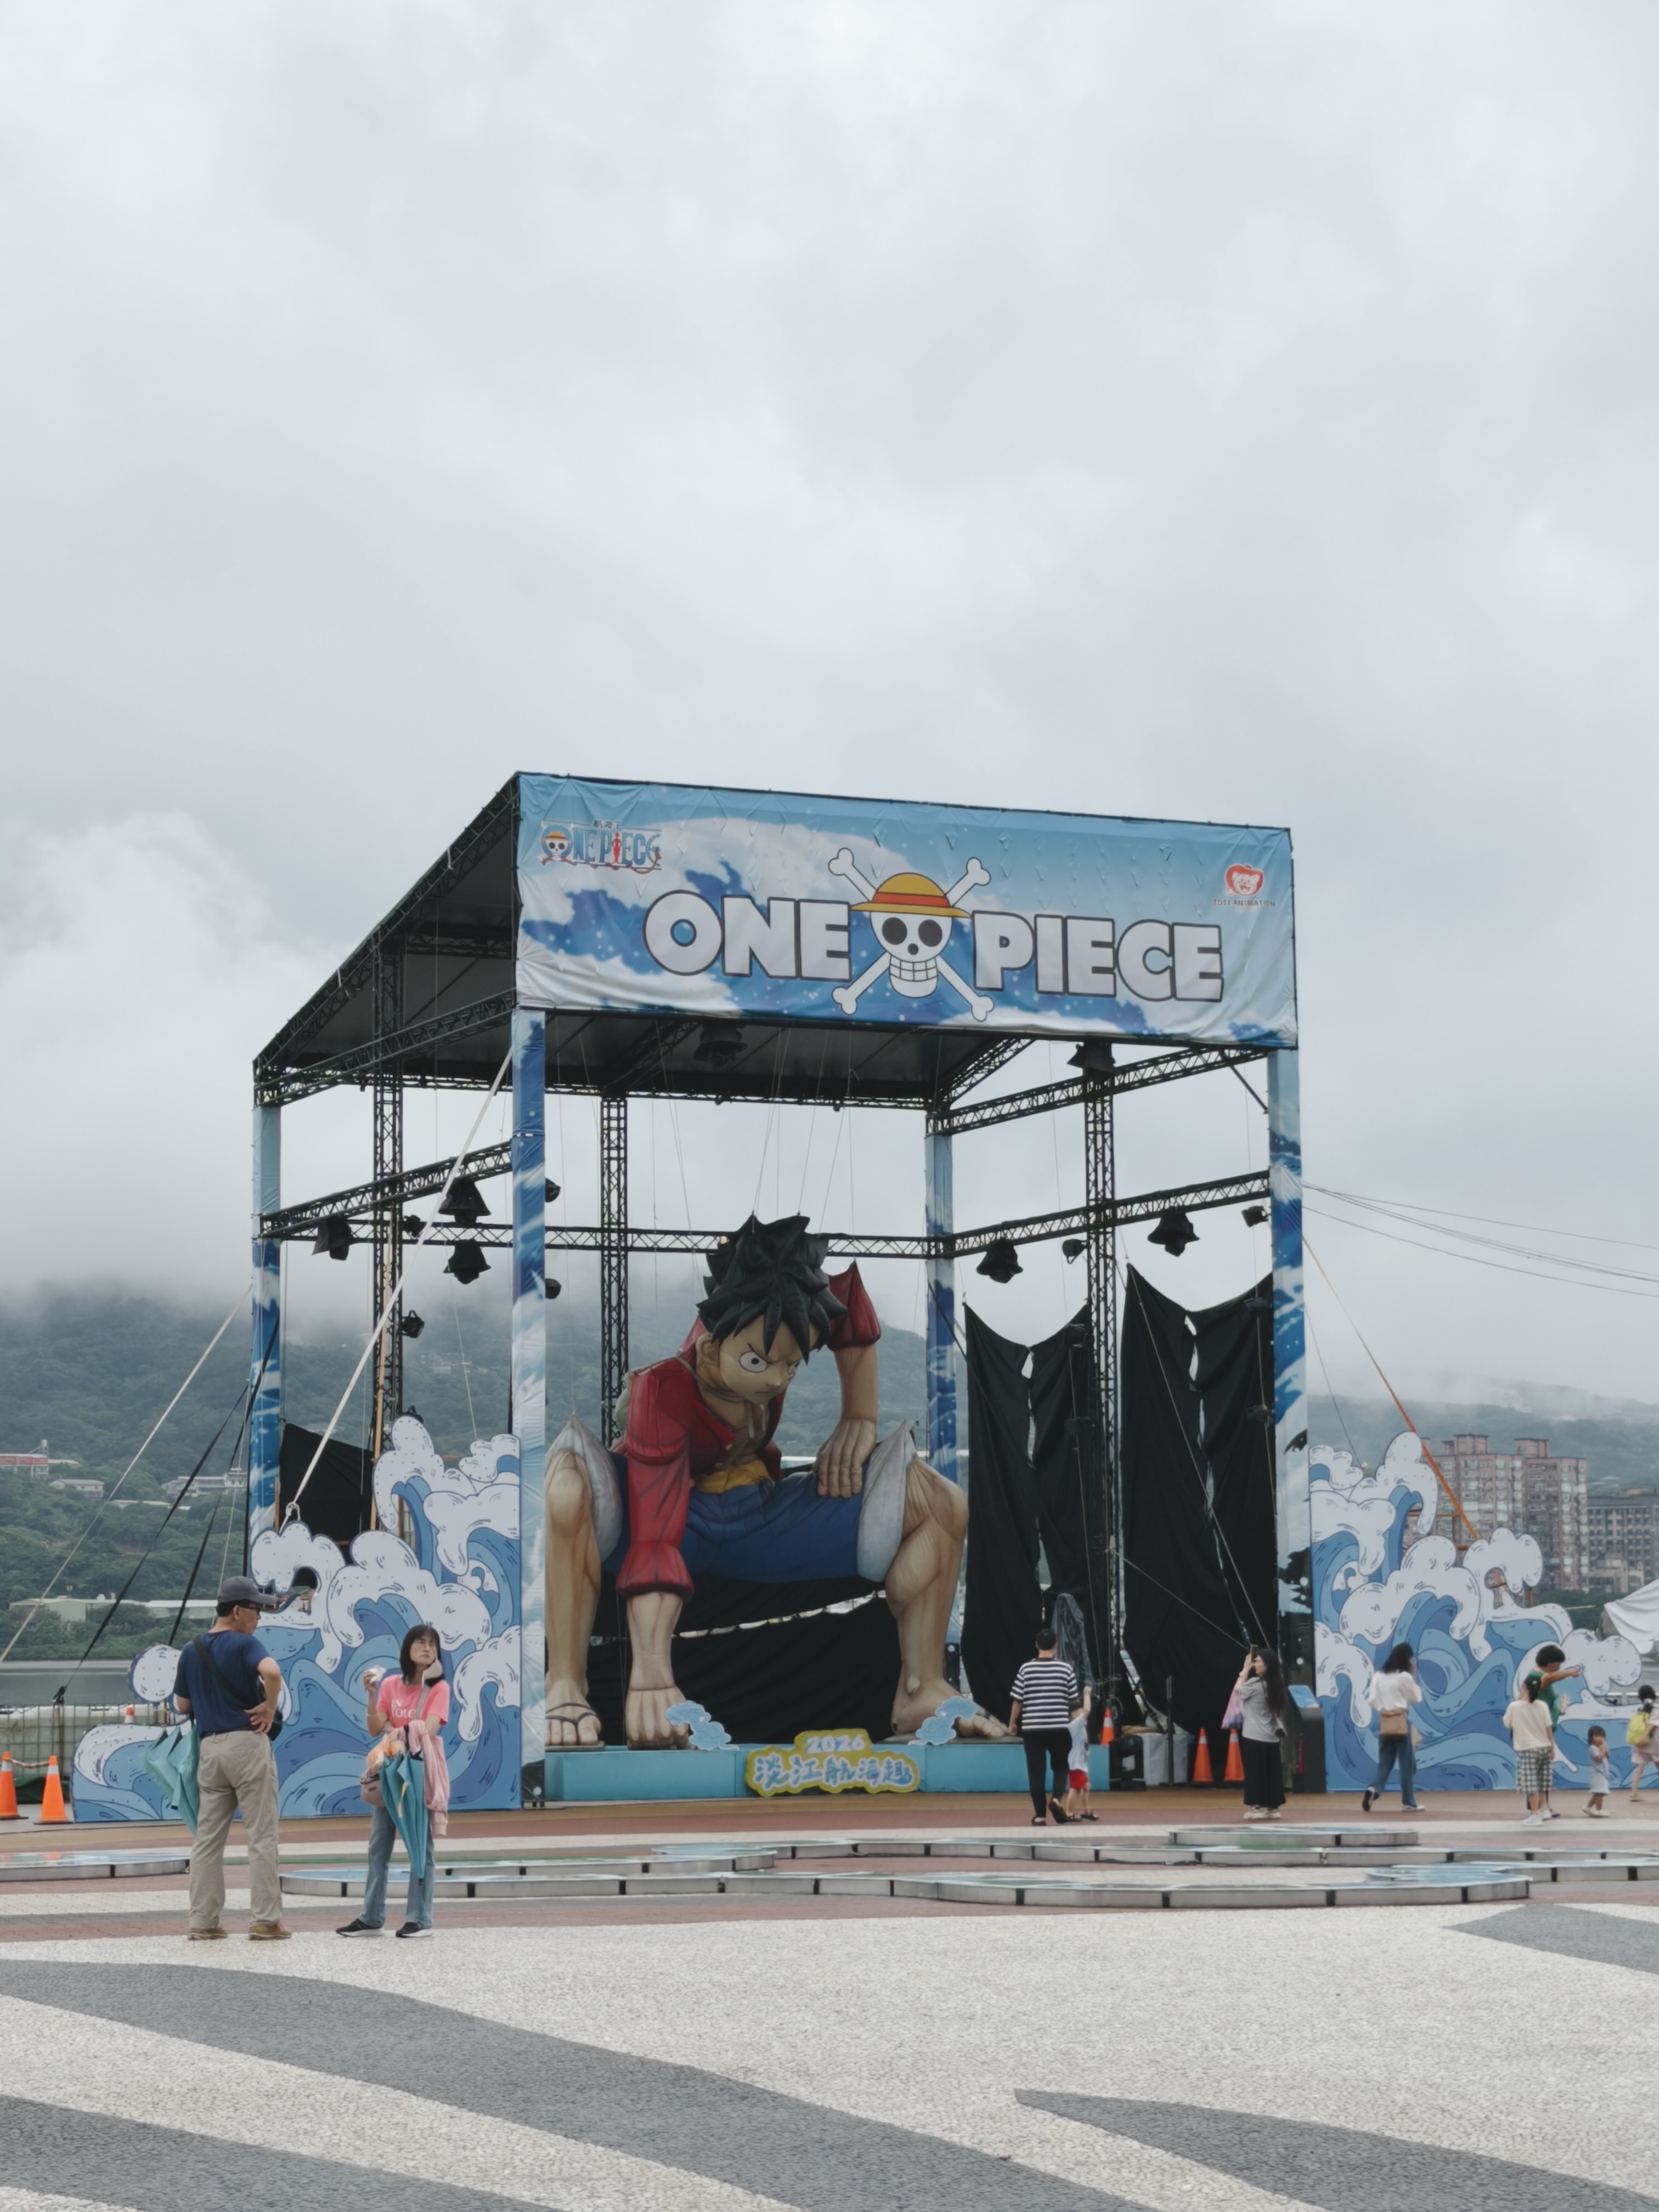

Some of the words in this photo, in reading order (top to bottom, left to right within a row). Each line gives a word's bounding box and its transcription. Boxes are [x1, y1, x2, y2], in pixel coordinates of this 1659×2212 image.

[541, 825, 598, 862] ONE
[600, 829, 661, 866] PIECE
[642, 889, 852, 982] ONE
[972, 910, 1224, 1002] PIECE
[806, 1734, 866, 1753] 2026
[754, 1753, 914, 1790] 淡江航海趣
